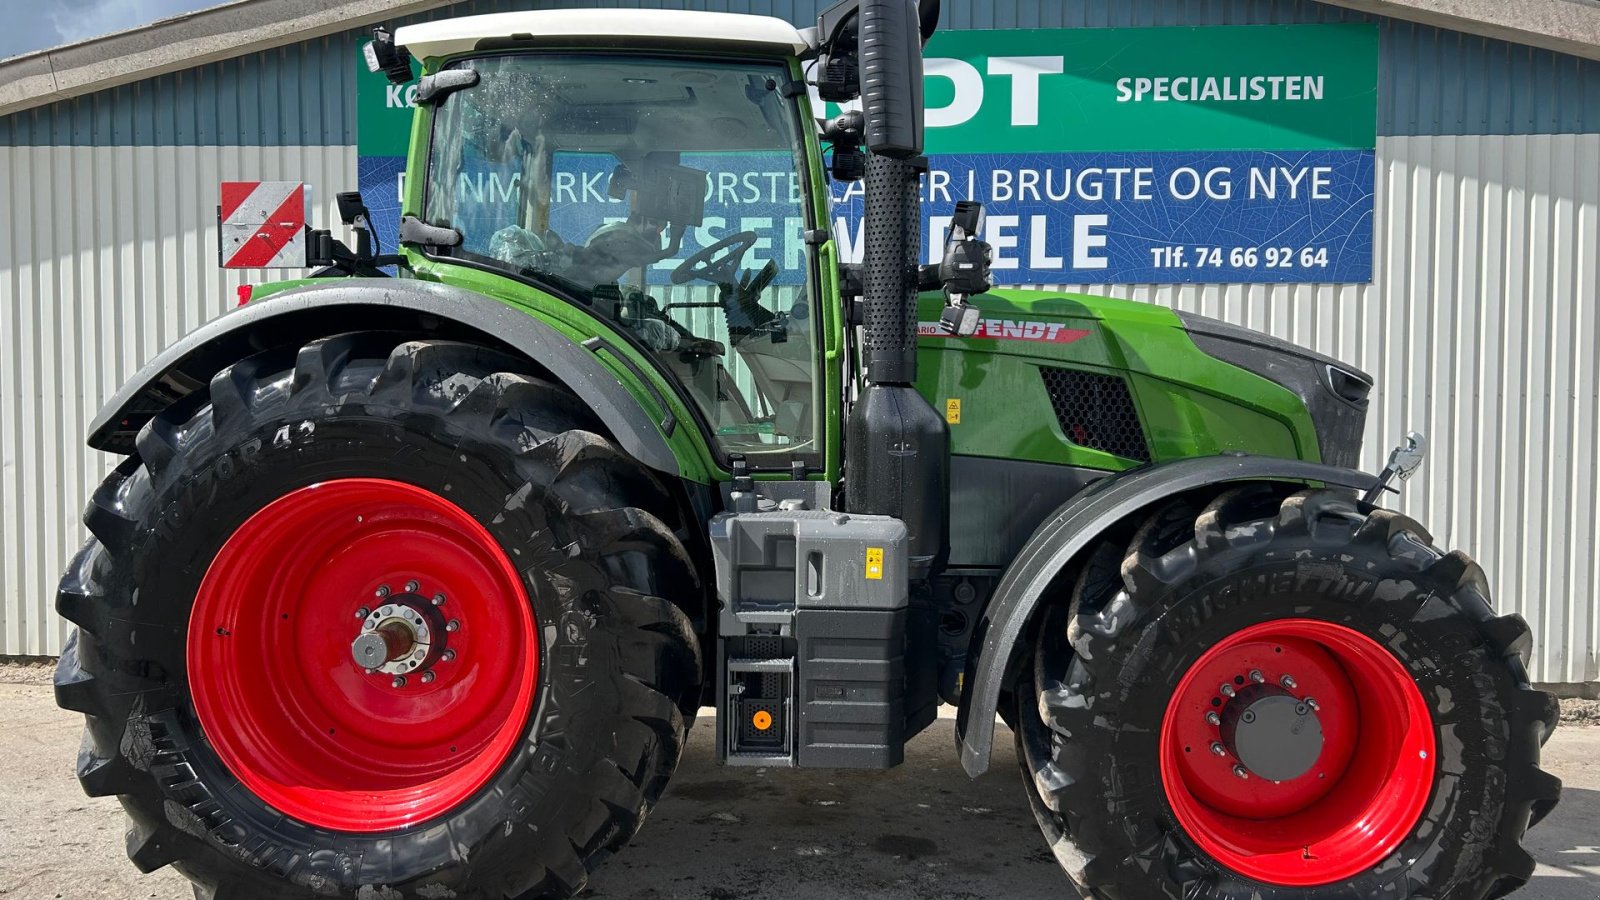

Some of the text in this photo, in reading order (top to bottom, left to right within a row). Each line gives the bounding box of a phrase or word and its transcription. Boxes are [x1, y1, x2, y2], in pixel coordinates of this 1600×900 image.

[1116, 76, 1324, 102] SPECIALISTEN
[968, 169, 974, 202] I
[992, 167, 1153, 202] BRUGTE
[1169, 166, 1231, 201] OG
[1250, 166, 1332, 200] NYE
[1151, 246, 1328, 268] Tlf. 74 66 92 64
